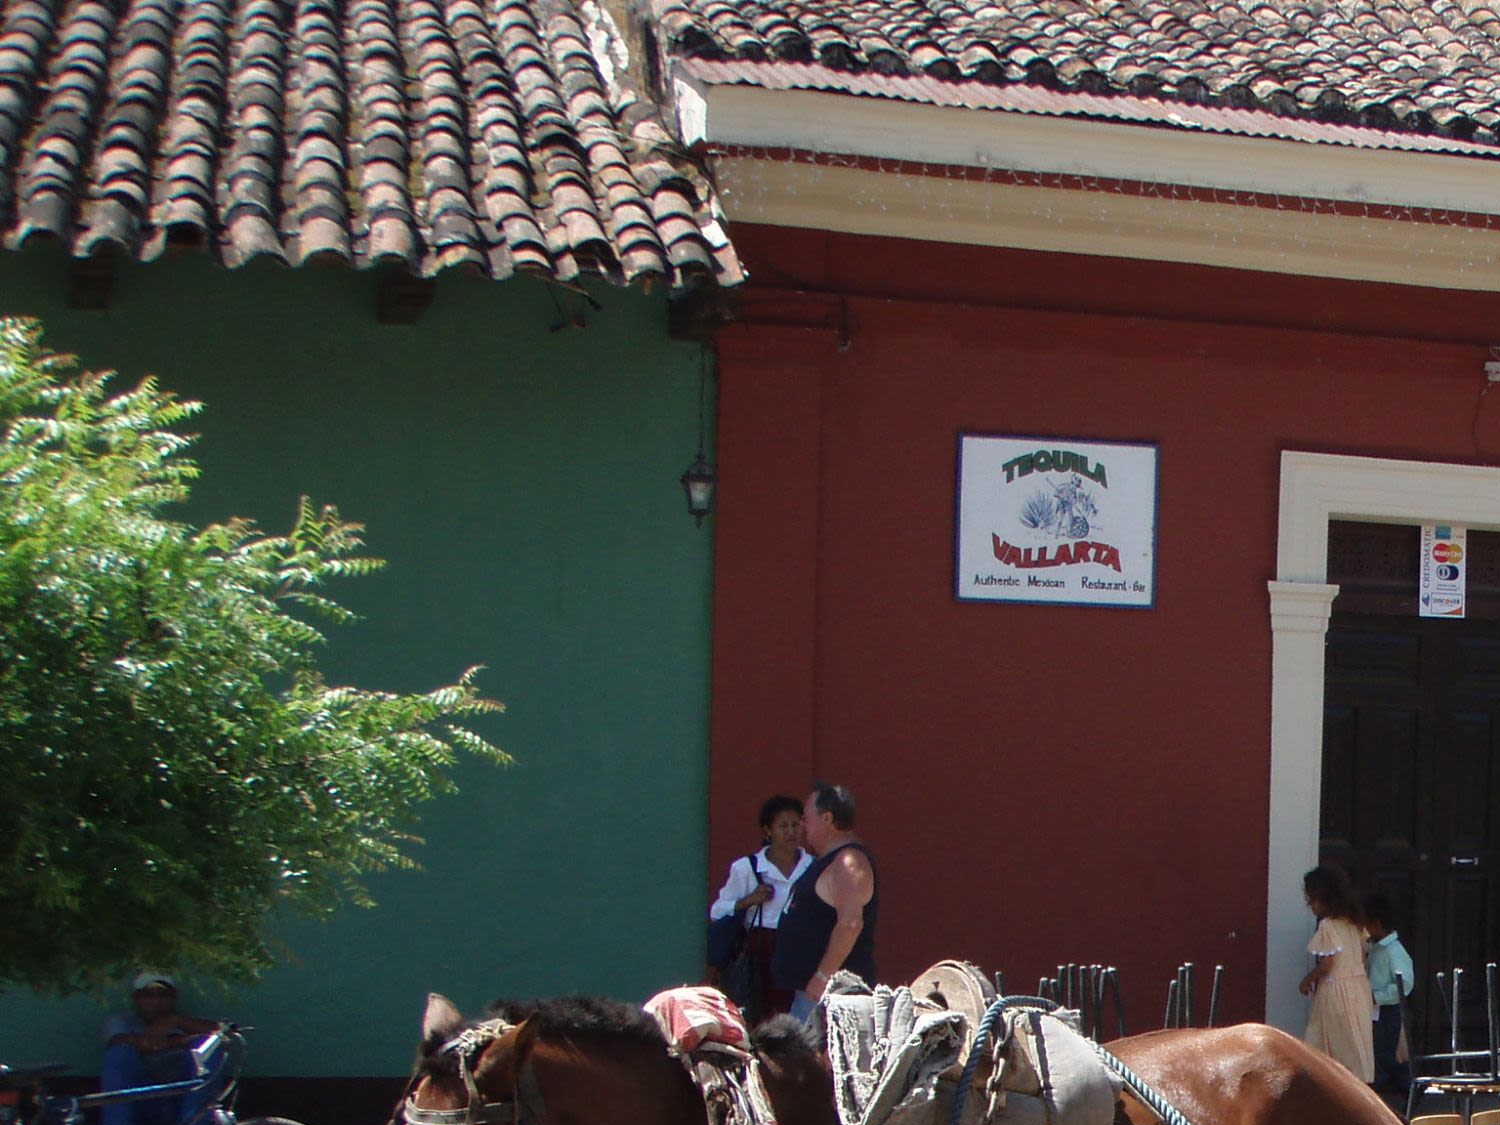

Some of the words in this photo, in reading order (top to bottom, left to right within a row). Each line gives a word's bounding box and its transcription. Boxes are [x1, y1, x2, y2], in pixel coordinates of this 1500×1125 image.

[1002, 449, 1108, 489] TEQUILA
[991, 531, 1122, 573] VALLARTA
[973, 575, 1021, 587] Authentic
[1027, 575, 1066, 588] Mexican
[1081, 577, 1127, 591] Restaurant
